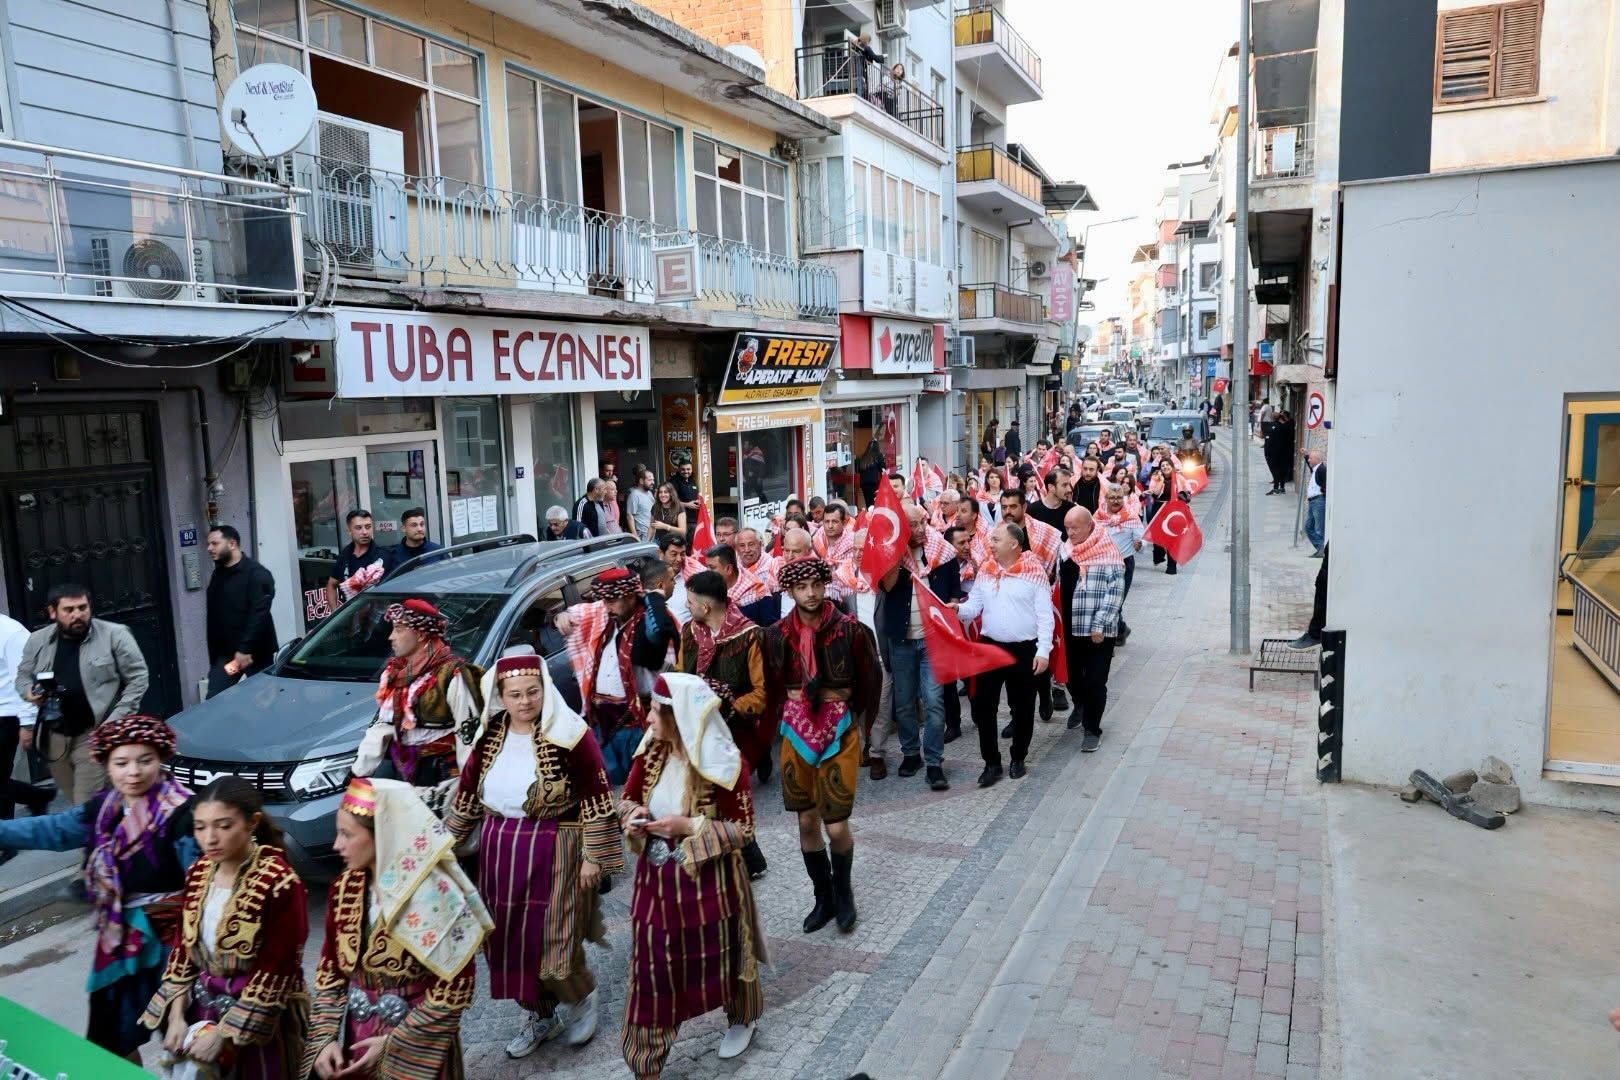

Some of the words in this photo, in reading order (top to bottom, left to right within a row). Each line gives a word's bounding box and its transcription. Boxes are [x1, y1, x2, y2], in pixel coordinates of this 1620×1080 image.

[245, 81, 261, 95] Next
[261, 80, 268, 95] &
[268, 80, 294, 94] NextStar
[663, 258, 688, 290] E
[350, 321, 473, 383] TUBA
[492, 329, 642, 383] ECZANESİ
[762, 338, 831, 366] FRESH
[893, 328, 934, 371] arçelik
[735, 415, 769, 430] FRESH
[667, 431, 693, 442] FRESH
[184, 531, 194, 540] 80
